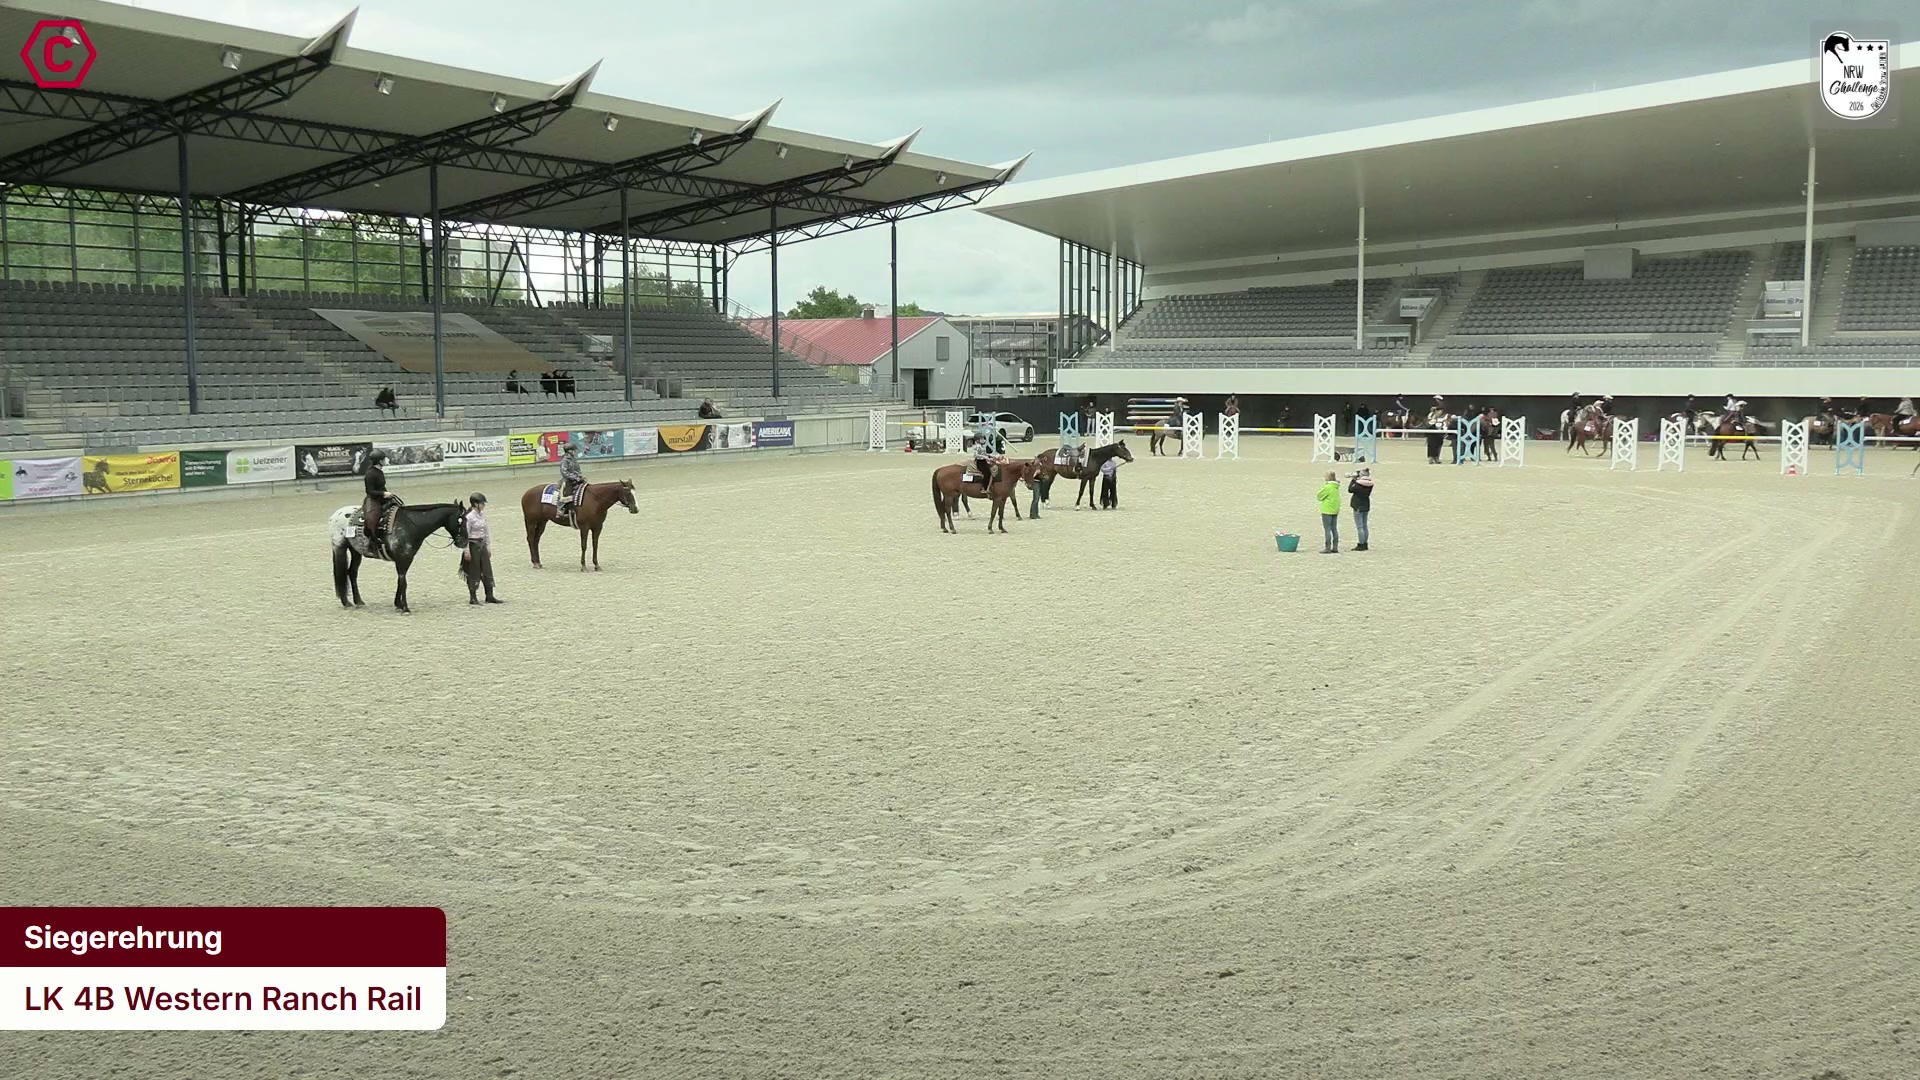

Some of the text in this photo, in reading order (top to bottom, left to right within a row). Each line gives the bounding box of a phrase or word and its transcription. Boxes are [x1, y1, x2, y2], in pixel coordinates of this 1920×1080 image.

[759, 426, 792, 438] AMERICANA
[445, 441, 476, 454] JUNG
[253, 456, 288, 465] Uelzener
